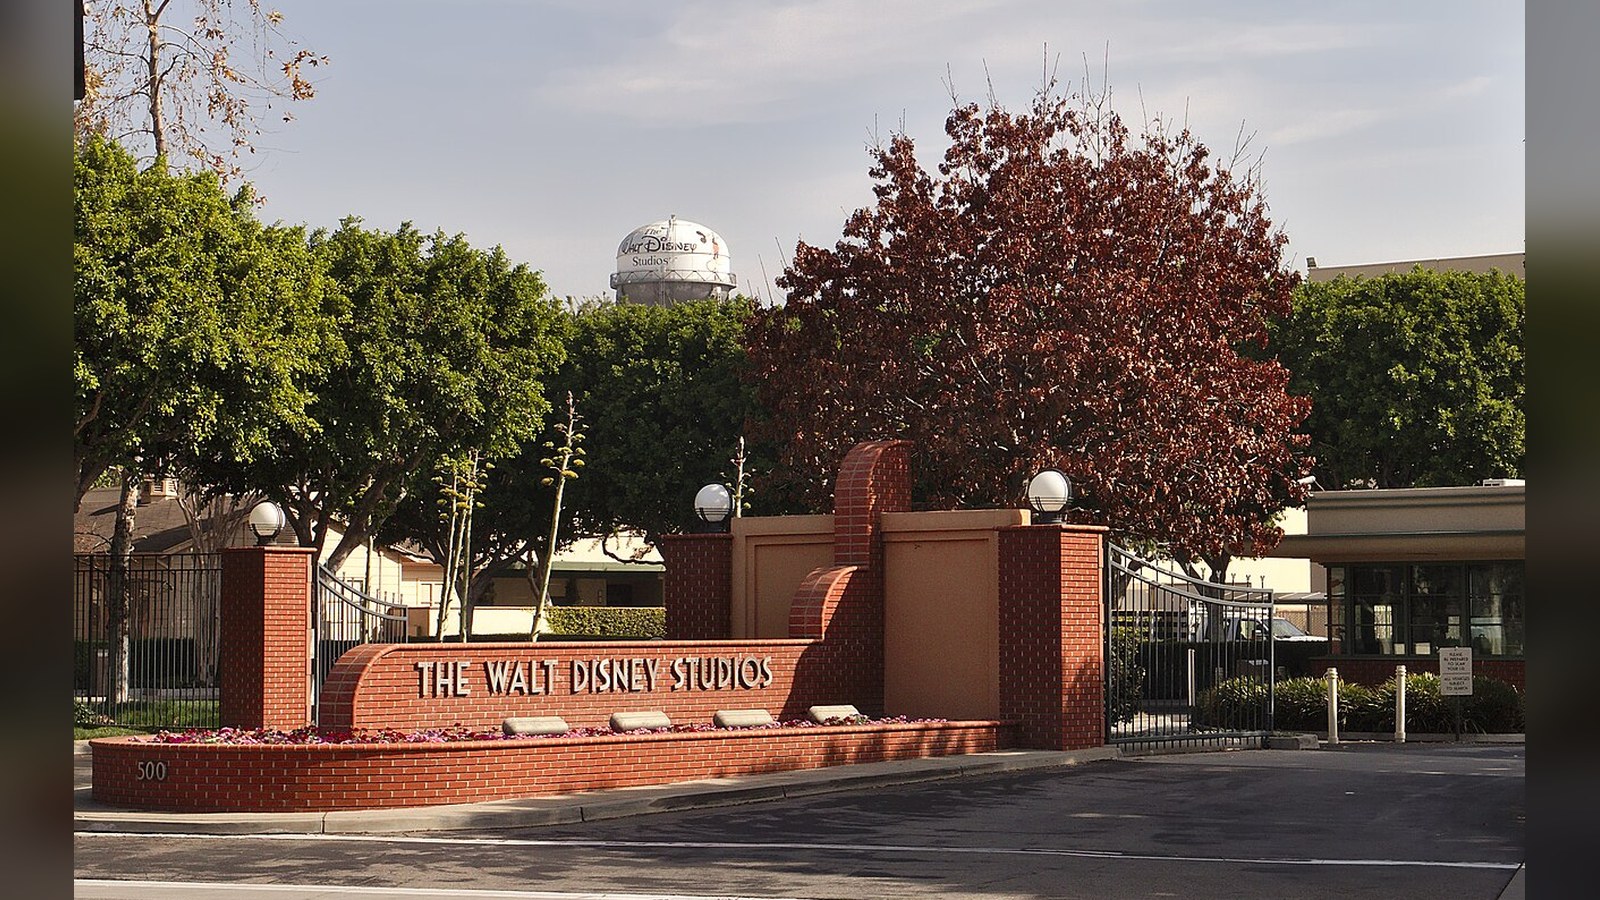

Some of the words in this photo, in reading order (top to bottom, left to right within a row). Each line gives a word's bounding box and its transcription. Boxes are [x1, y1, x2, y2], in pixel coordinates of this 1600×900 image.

[632, 256, 669, 267] Studios
[414, 661, 472, 699] THE
[484, 659, 559, 697] WALT
[570, 658, 661, 695] DISNEY
[670, 655, 774, 691] STUDIOS
[137, 761, 166, 781] 500
